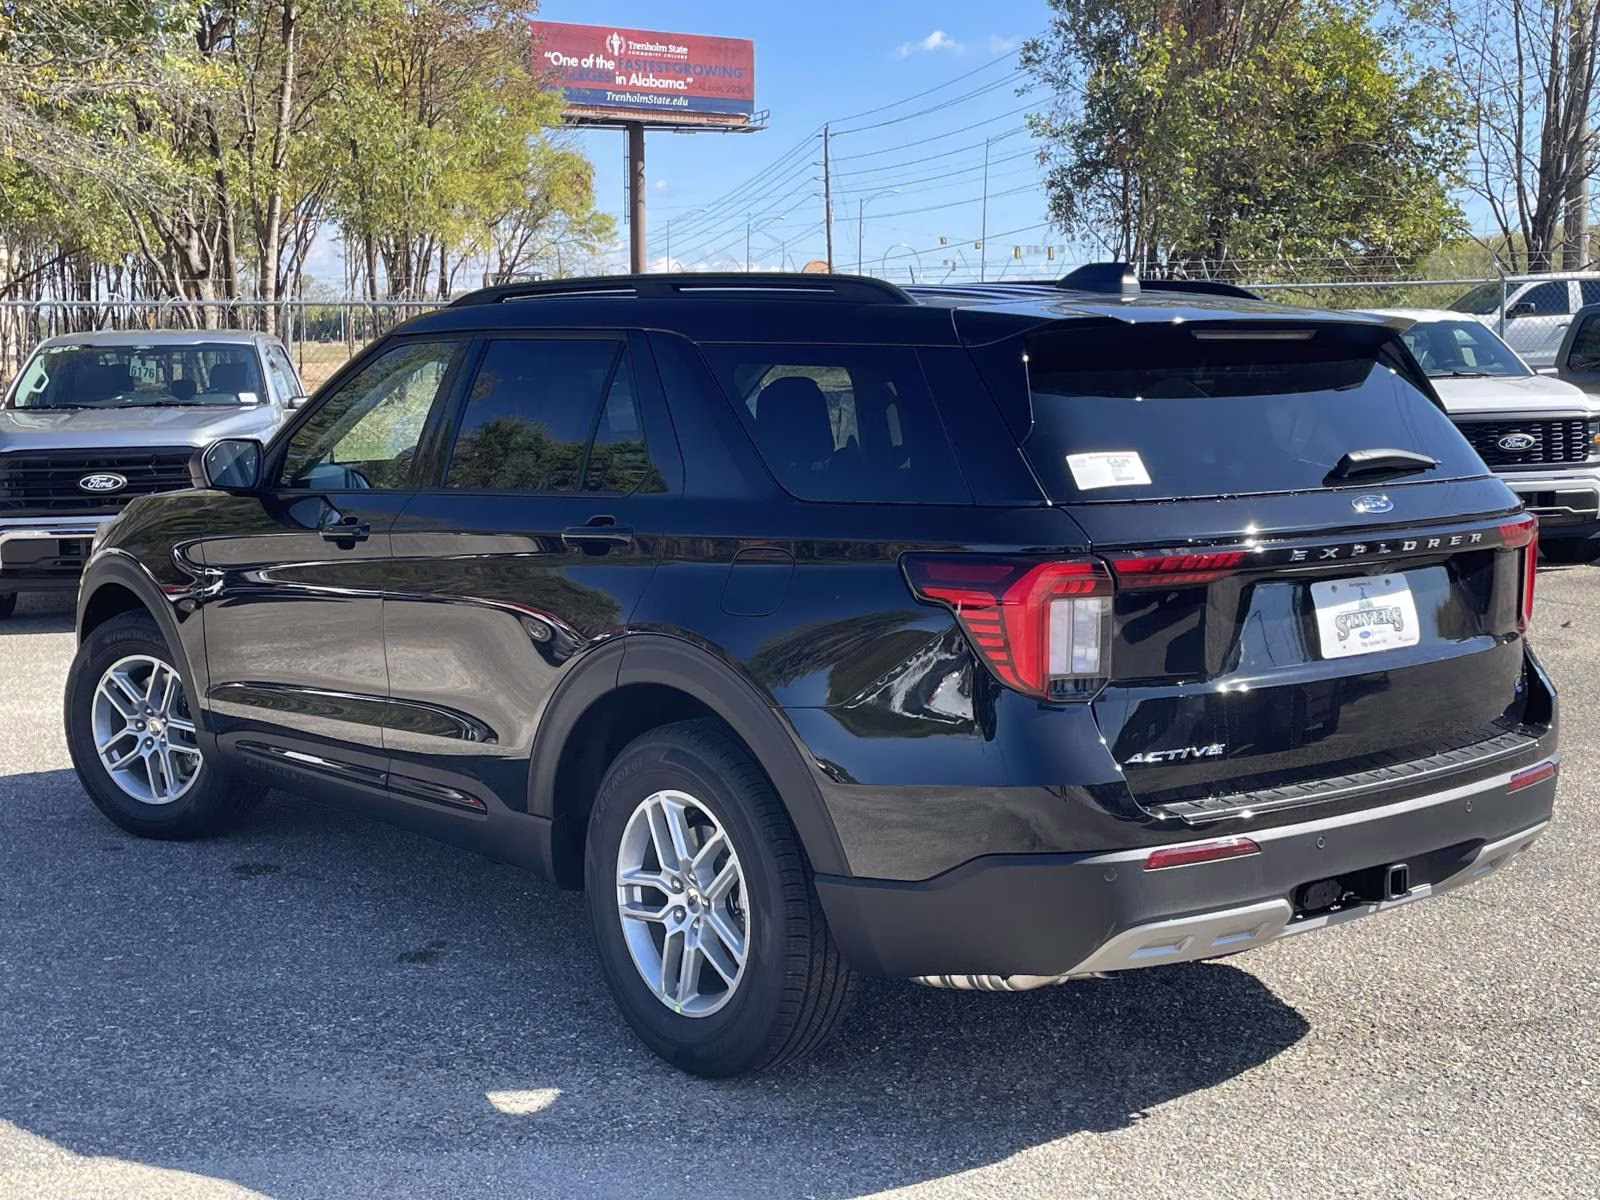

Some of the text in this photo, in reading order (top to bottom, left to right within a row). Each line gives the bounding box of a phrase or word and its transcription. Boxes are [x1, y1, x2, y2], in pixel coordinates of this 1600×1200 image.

[627, 41, 688, 54] Trenholm State
[581, 54, 595, 69] of
[595, 55, 615, 70] the
[618, 57, 671, 74] FASTEST
[673, 61, 744, 80] GROWING
[615, 71, 627, 86] in
[606, 91, 689, 106] TrenholmState.edu
[131, 364, 155, 378] 6176
[1505, 438, 1527, 448] Ford
[87, 476, 115, 489] Ford
[1289, 532, 1484, 562] EXPLORER
[1335, 606, 1404, 642] STIVERS
[1123, 743, 1226, 765] ACTIVE
